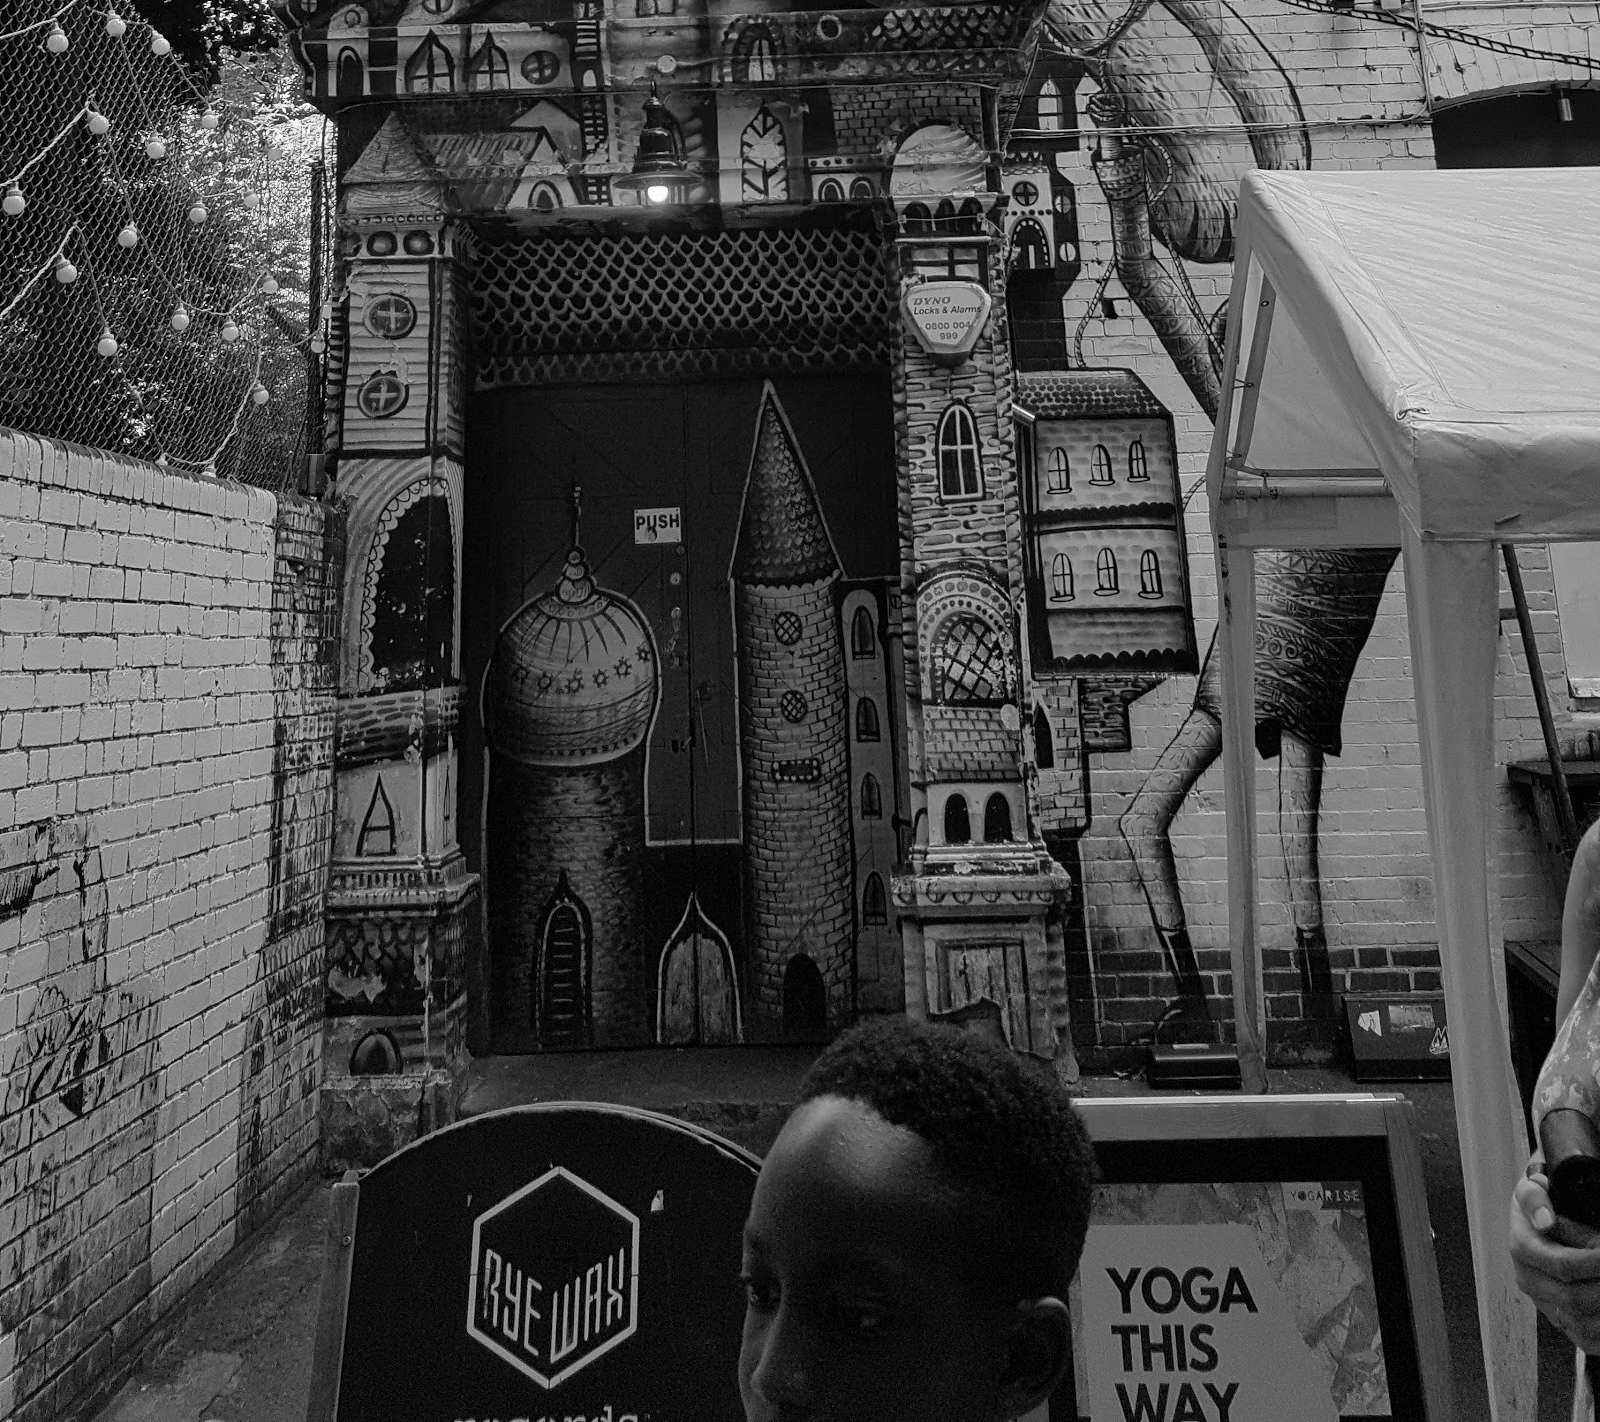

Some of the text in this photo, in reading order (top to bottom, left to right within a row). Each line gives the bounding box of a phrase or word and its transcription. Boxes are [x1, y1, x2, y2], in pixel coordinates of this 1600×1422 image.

[913, 296, 951, 306] DYNO
[913, 305, 982, 315] Locks & Alarms
[925, 322, 950, 330] 0800
[939, 332, 958, 340] 999
[636, 513, 680, 531] PUSH
[1105, 1266, 1259, 1315] YOGA
[482, 1247, 626, 1364] RYE WAX
[1110, 1323, 1219, 1373] THIS
[1114, 1382, 1241, 1422] WAY
